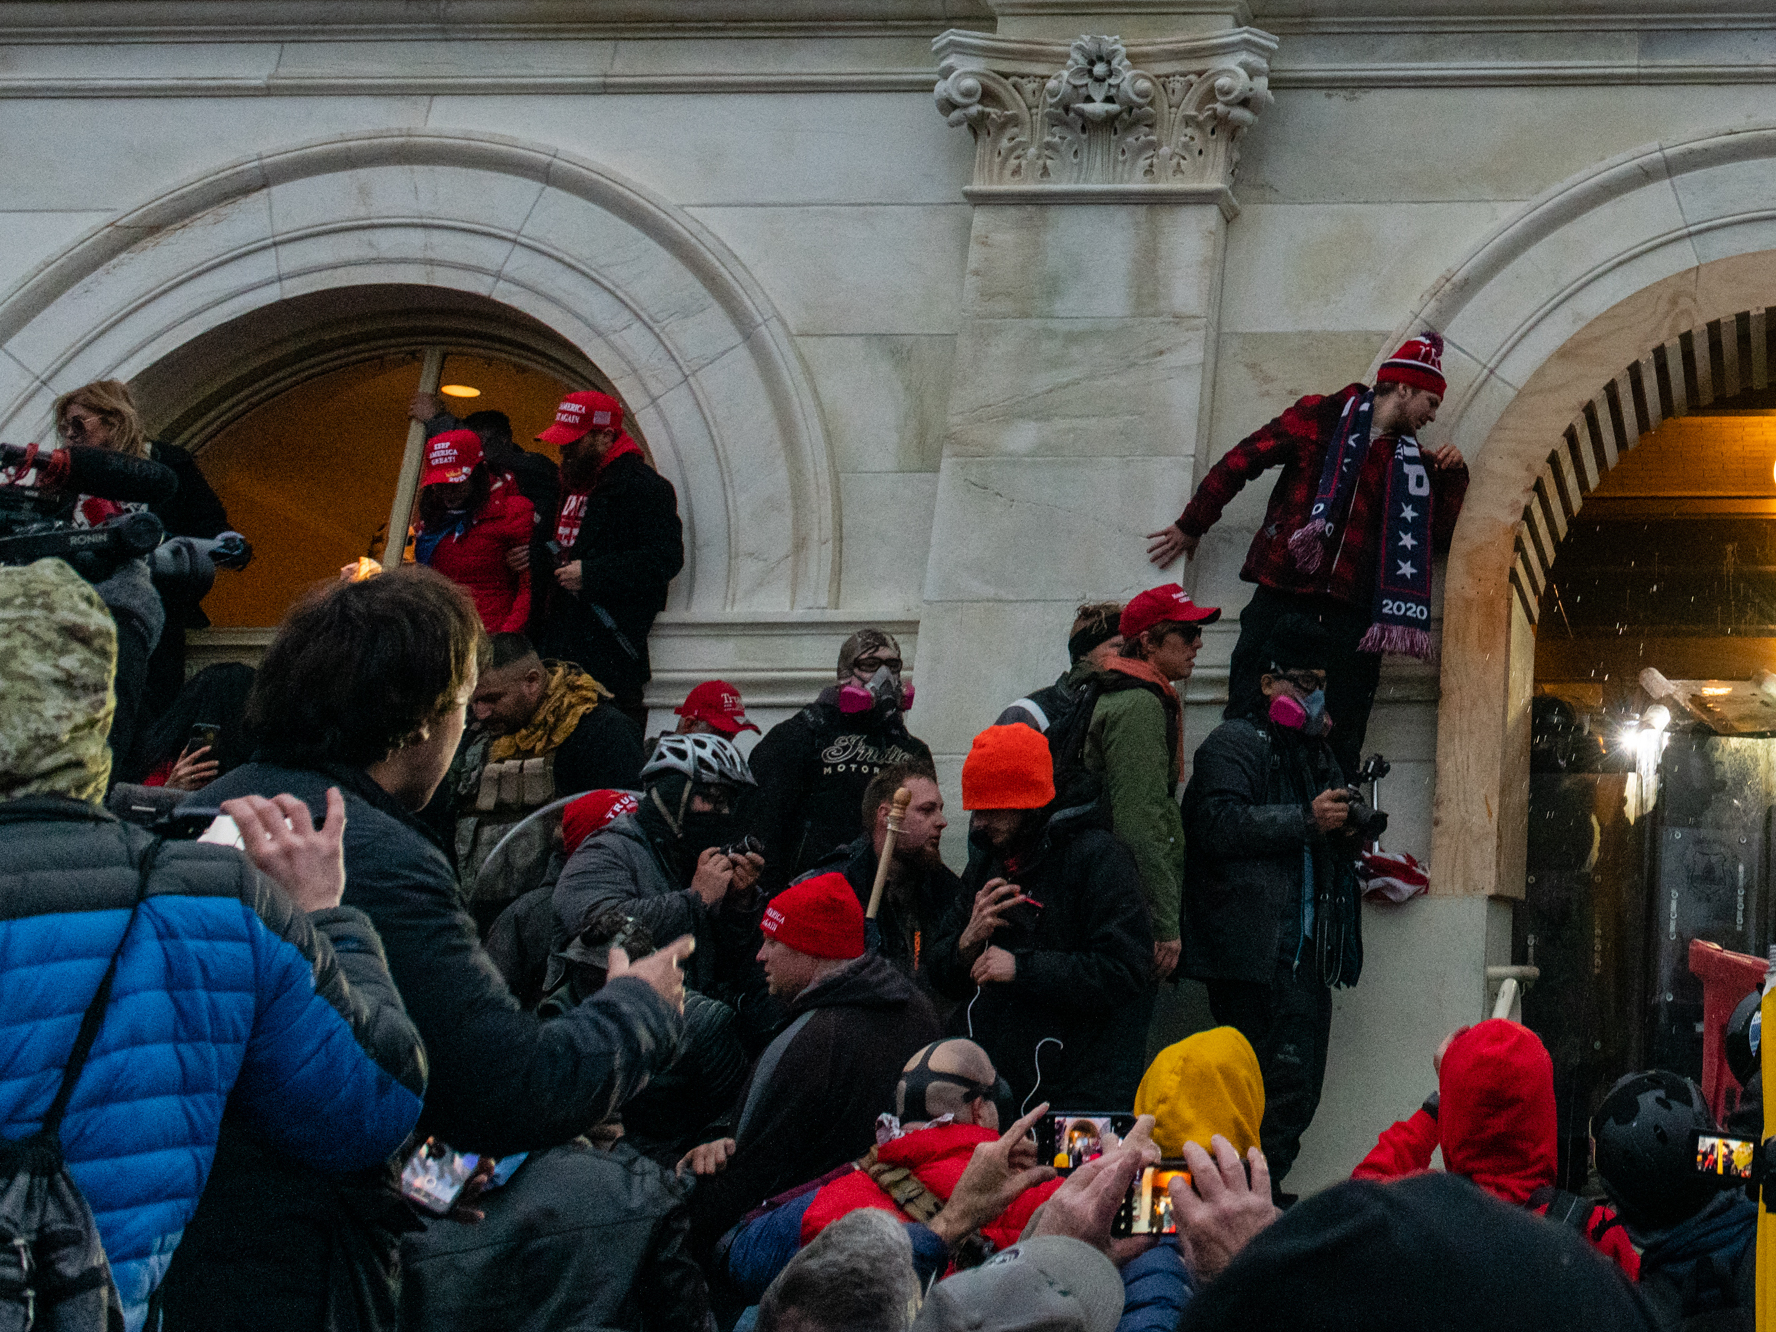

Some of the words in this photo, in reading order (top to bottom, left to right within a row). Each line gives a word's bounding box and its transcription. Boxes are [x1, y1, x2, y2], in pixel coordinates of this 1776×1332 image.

[434, 442, 450, 450] KEEP
[429, 449, 458, 458] AMERICA
[431, 456, 455, 465] GREAT!
[70, 532, 108, 546] RONIN
[1382, 599, 1429, 619] 2020
